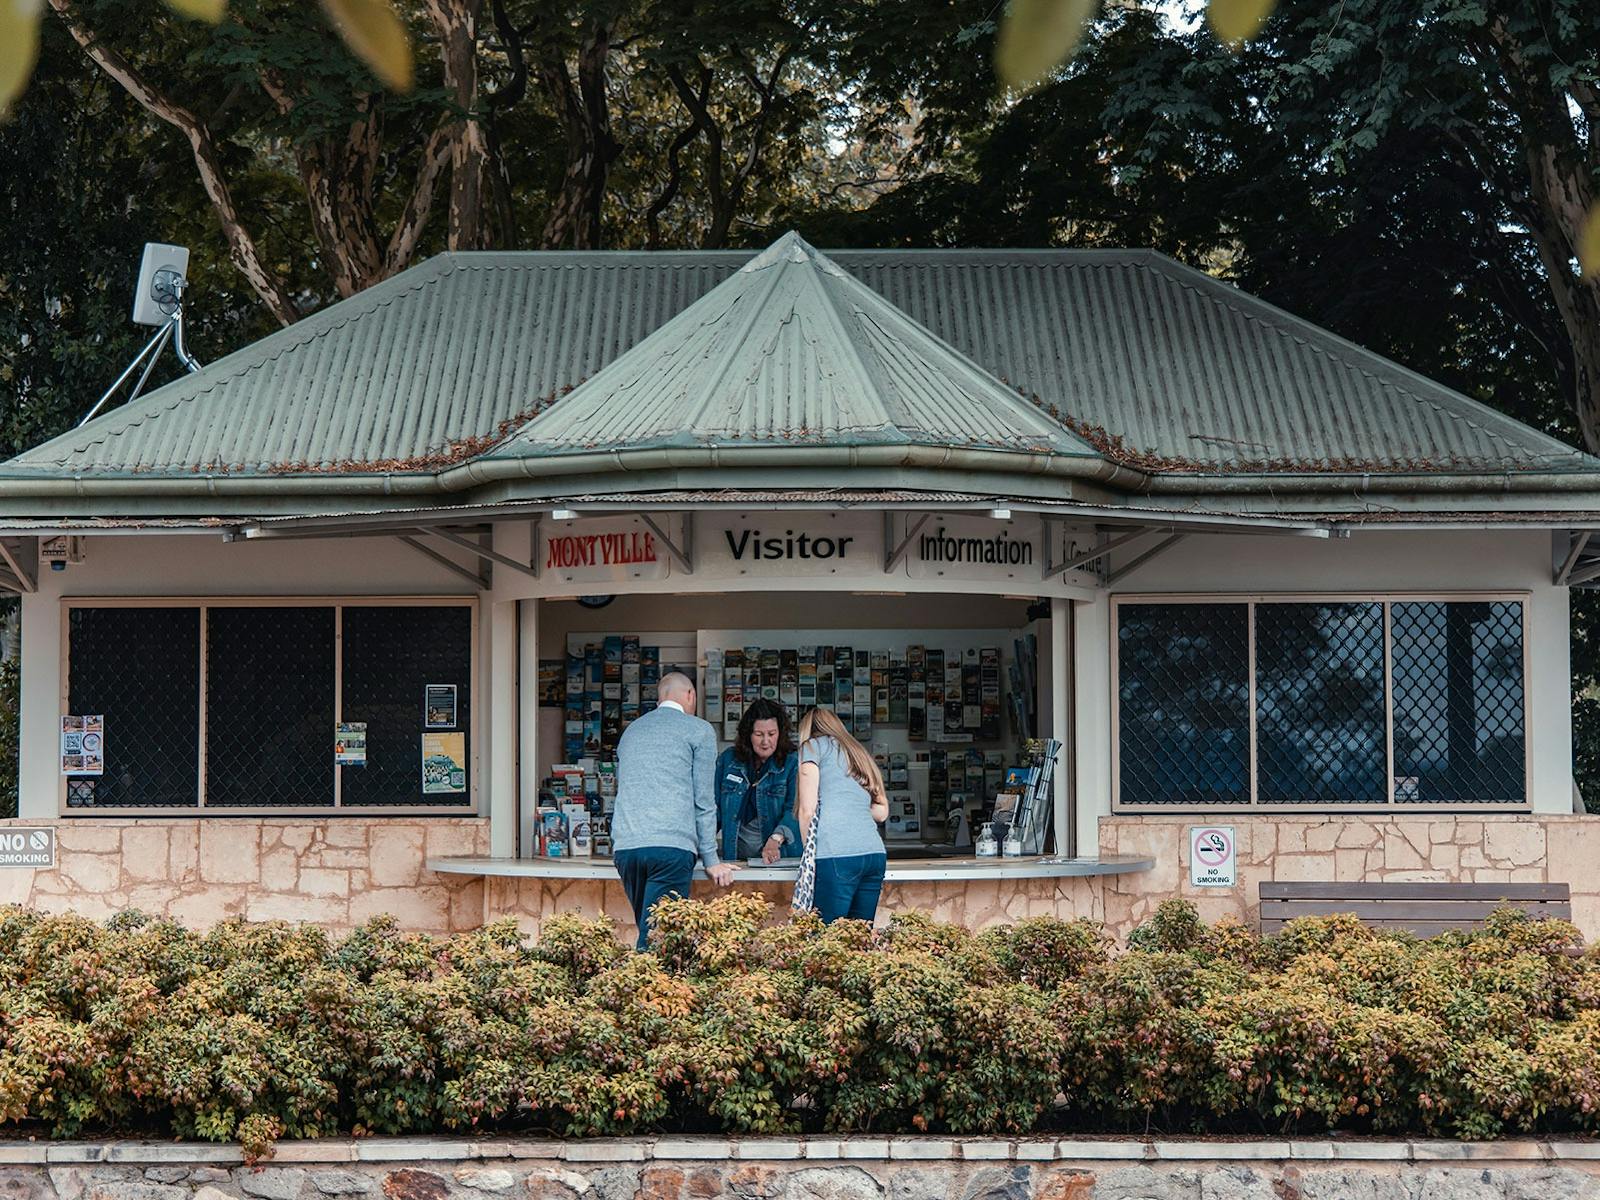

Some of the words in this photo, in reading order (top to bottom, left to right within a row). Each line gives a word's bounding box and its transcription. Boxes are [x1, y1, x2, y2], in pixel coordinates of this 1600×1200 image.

[547, 532, 657, 568] MONTVILLE
[725, 529, 854, 561] Visitor
[919, 527, 1033, 565] Information
[0, 834, 25, 851] NO
[0, 854, 49, 863] SMOKING
